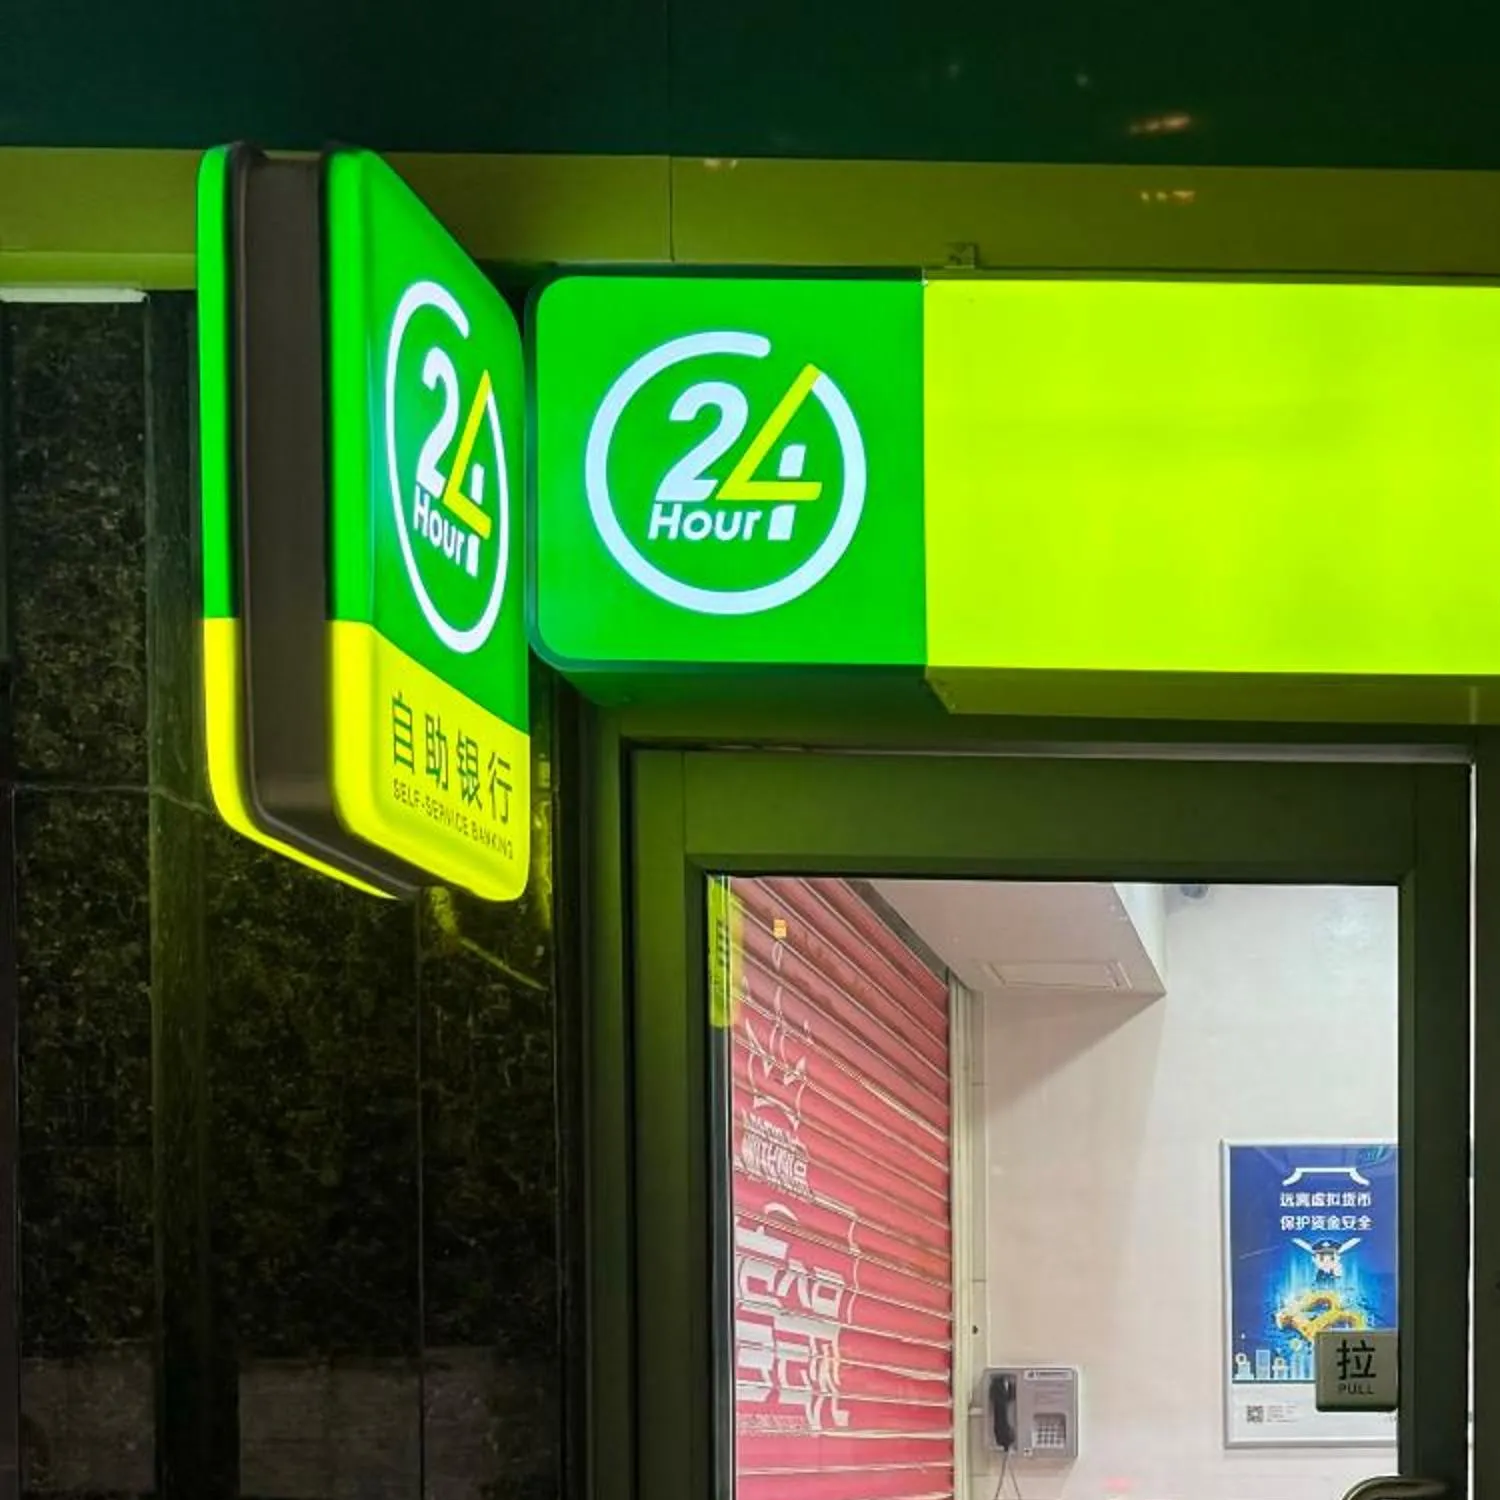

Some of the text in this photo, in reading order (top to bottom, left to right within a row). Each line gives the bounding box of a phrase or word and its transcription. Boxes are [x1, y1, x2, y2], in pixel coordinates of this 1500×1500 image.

[413, 484, 464, 566] Hour
[648, 504, 761, 541] Hour
[392, 690, 513, 825] 自助银行
[393, 777, 513, 860] SELF-SERVICE BANKING
[1280, 1215, 1373, 1231] 保护资金安全
[1336, 1338, 1377, 1380] 拉
[1338, 1383, 1375, 1395] PULL
